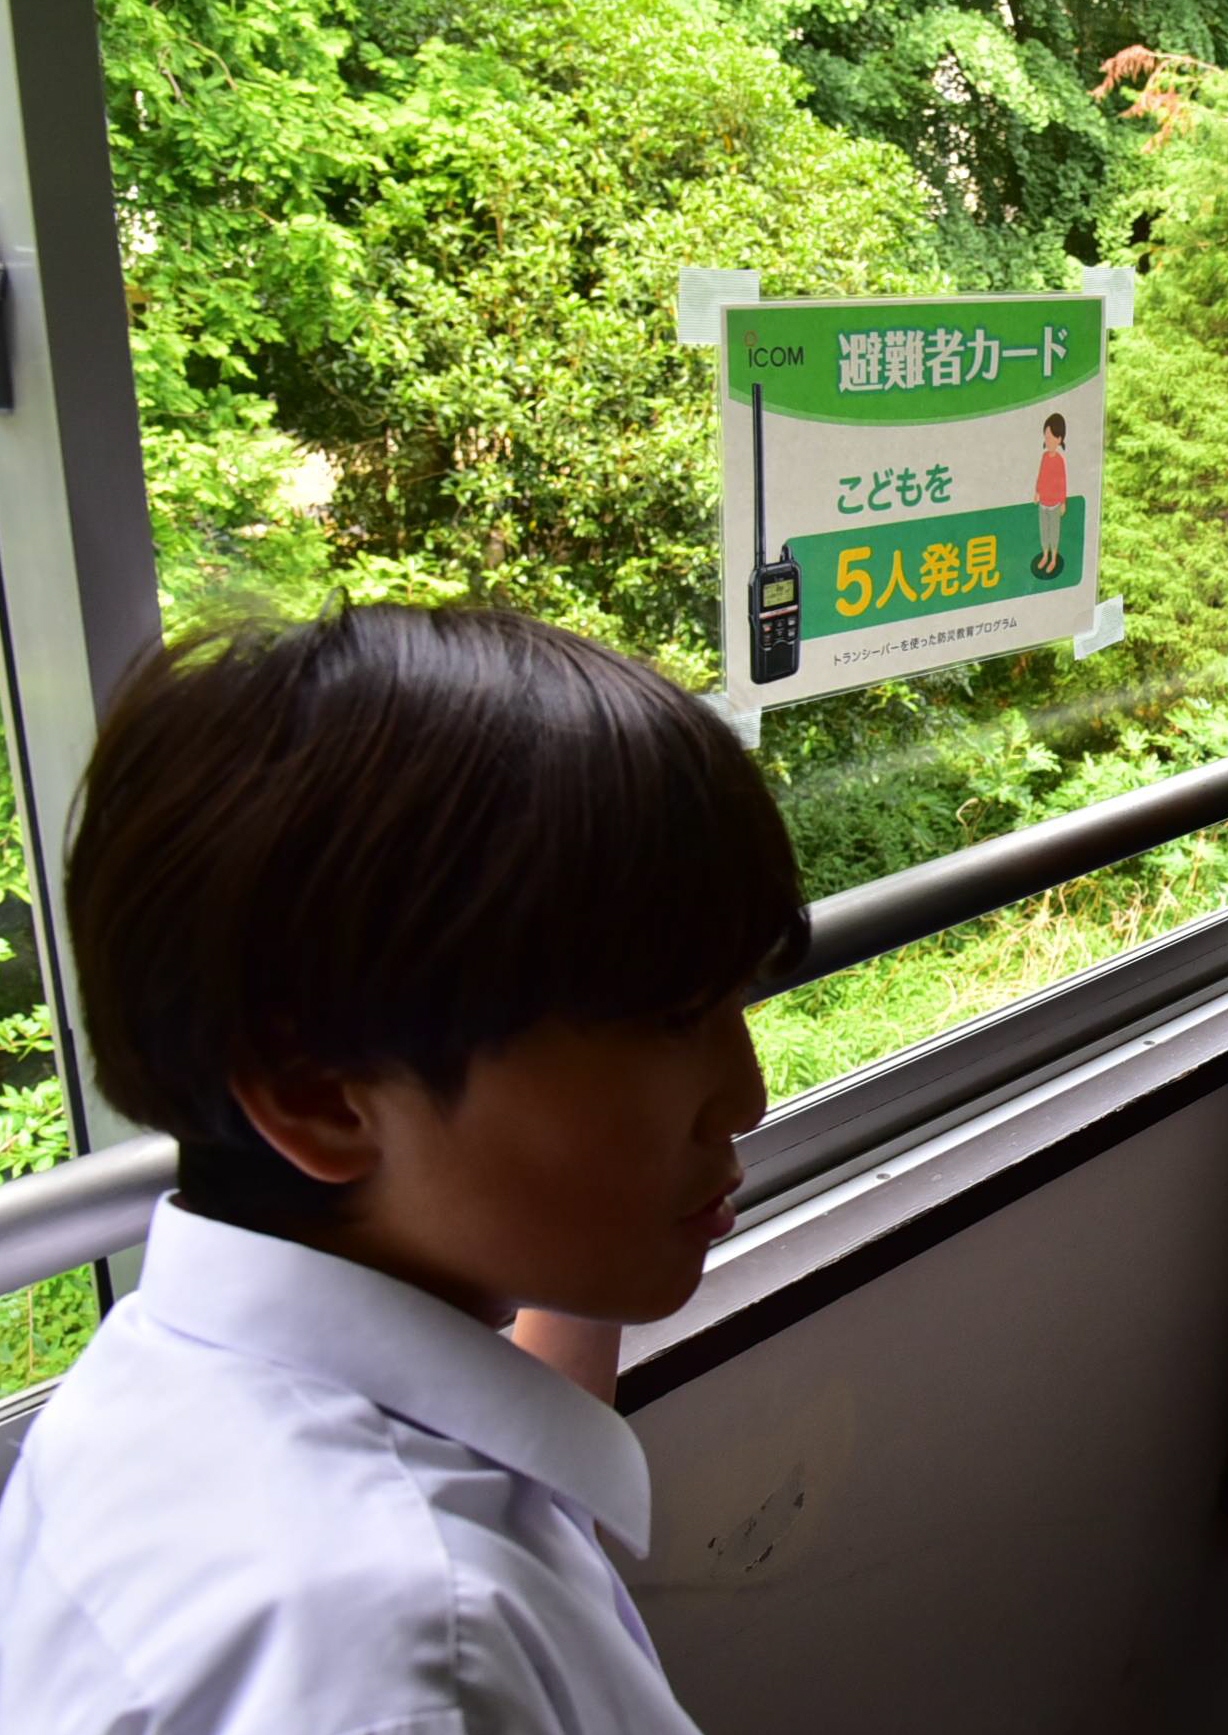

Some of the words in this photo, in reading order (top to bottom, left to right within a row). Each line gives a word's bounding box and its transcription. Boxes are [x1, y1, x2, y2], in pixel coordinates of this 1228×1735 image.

[838, 325, 1067, 393] 避難者カード
[837, 464, 953, 515] こどもを
[835, 534, 1001, 618] 5人発見
[833, 617, 1018, 666] トランシーバーを使った防災教育プログラム
